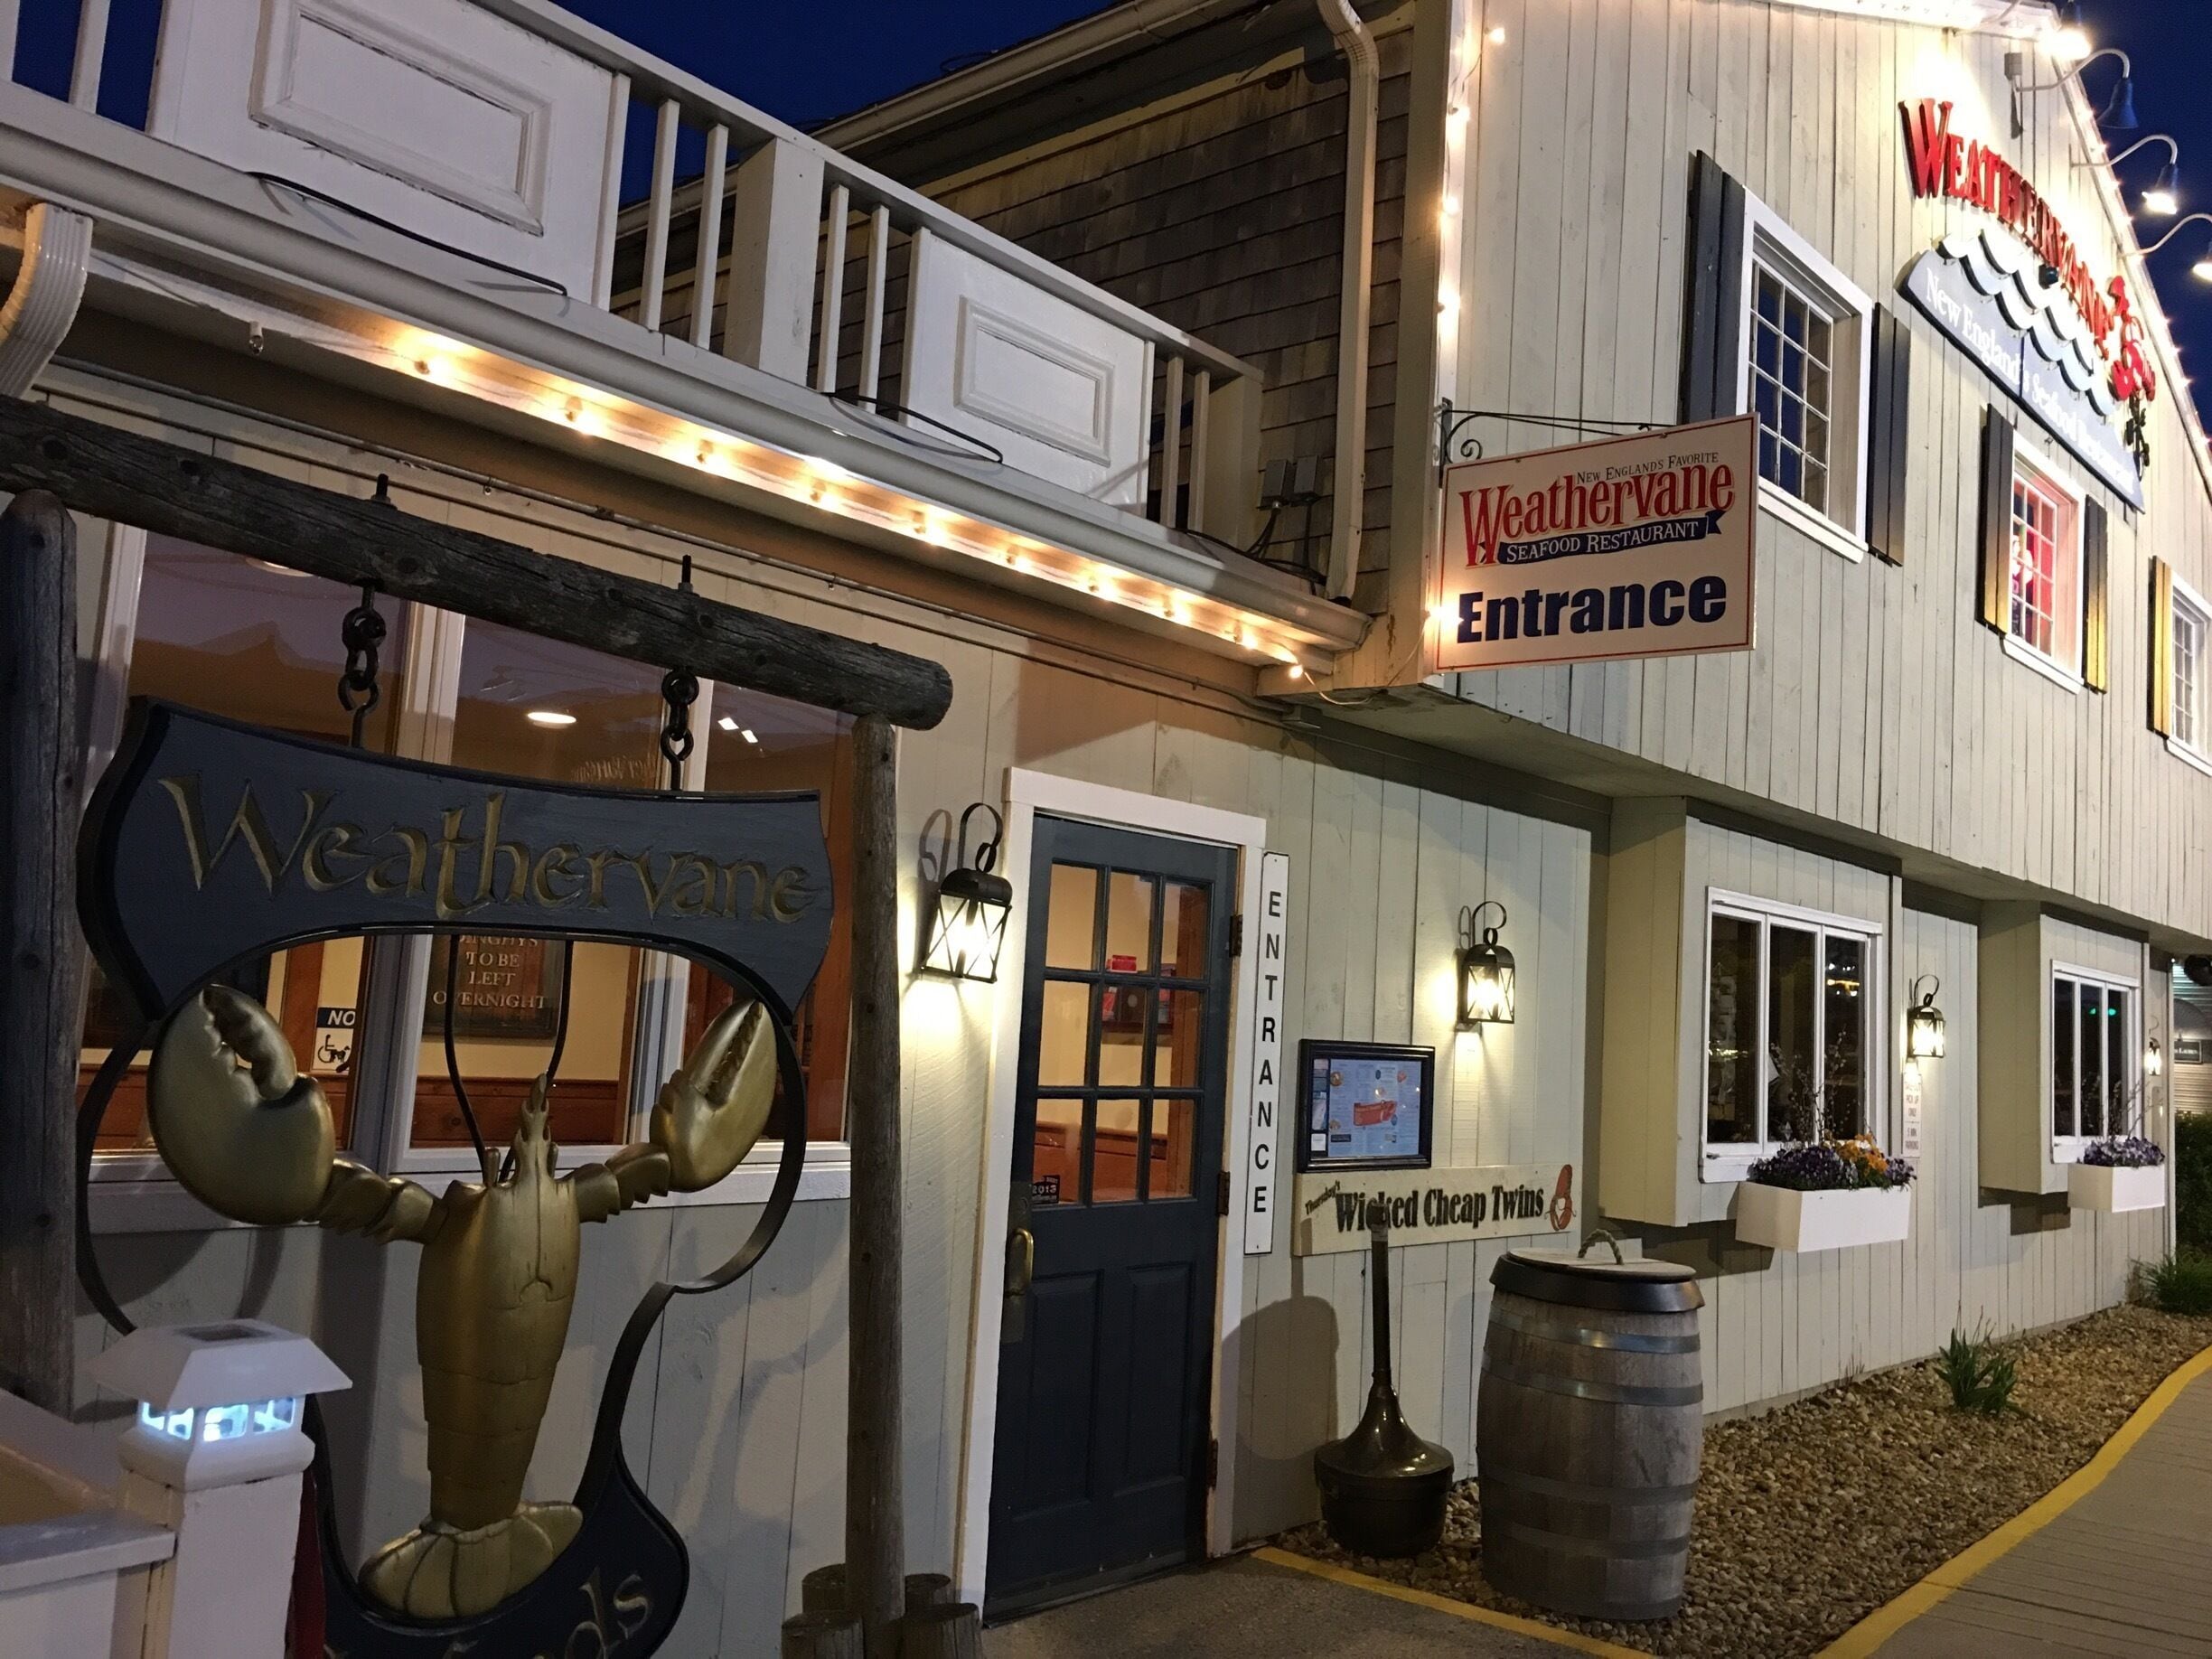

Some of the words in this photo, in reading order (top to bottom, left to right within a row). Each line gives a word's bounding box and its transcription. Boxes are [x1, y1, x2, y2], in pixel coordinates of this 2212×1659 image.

[1926, 267, 1963, 326] New
[1577, 471, 1601, 485] NEW
[1667, 451, 1720, 469] FAVORITE
[1458, 463, 1735, 568] Weathervane
[1506, 536, 1580, 564] SEAFOOD
[1586, 520, 1699, 554] RESTAURANT
[1456, 575, 1728, 644] Entrance
[156, 773, 824, 923] Weathervane
[466, 951, 493, 966] TO
[498, 953, 521, 968] BE
[468, 970, 517, 987] LEFT
[327, 1010, 356, 1026] NO
[433, 991, 548, 1009] OERNIGHT
[1253, 891, 1282, 1214] ENTRANCE
[1423, 1188, 1487, 1229] Cheap
[1492, 1184, 1544, 1222] Twins
